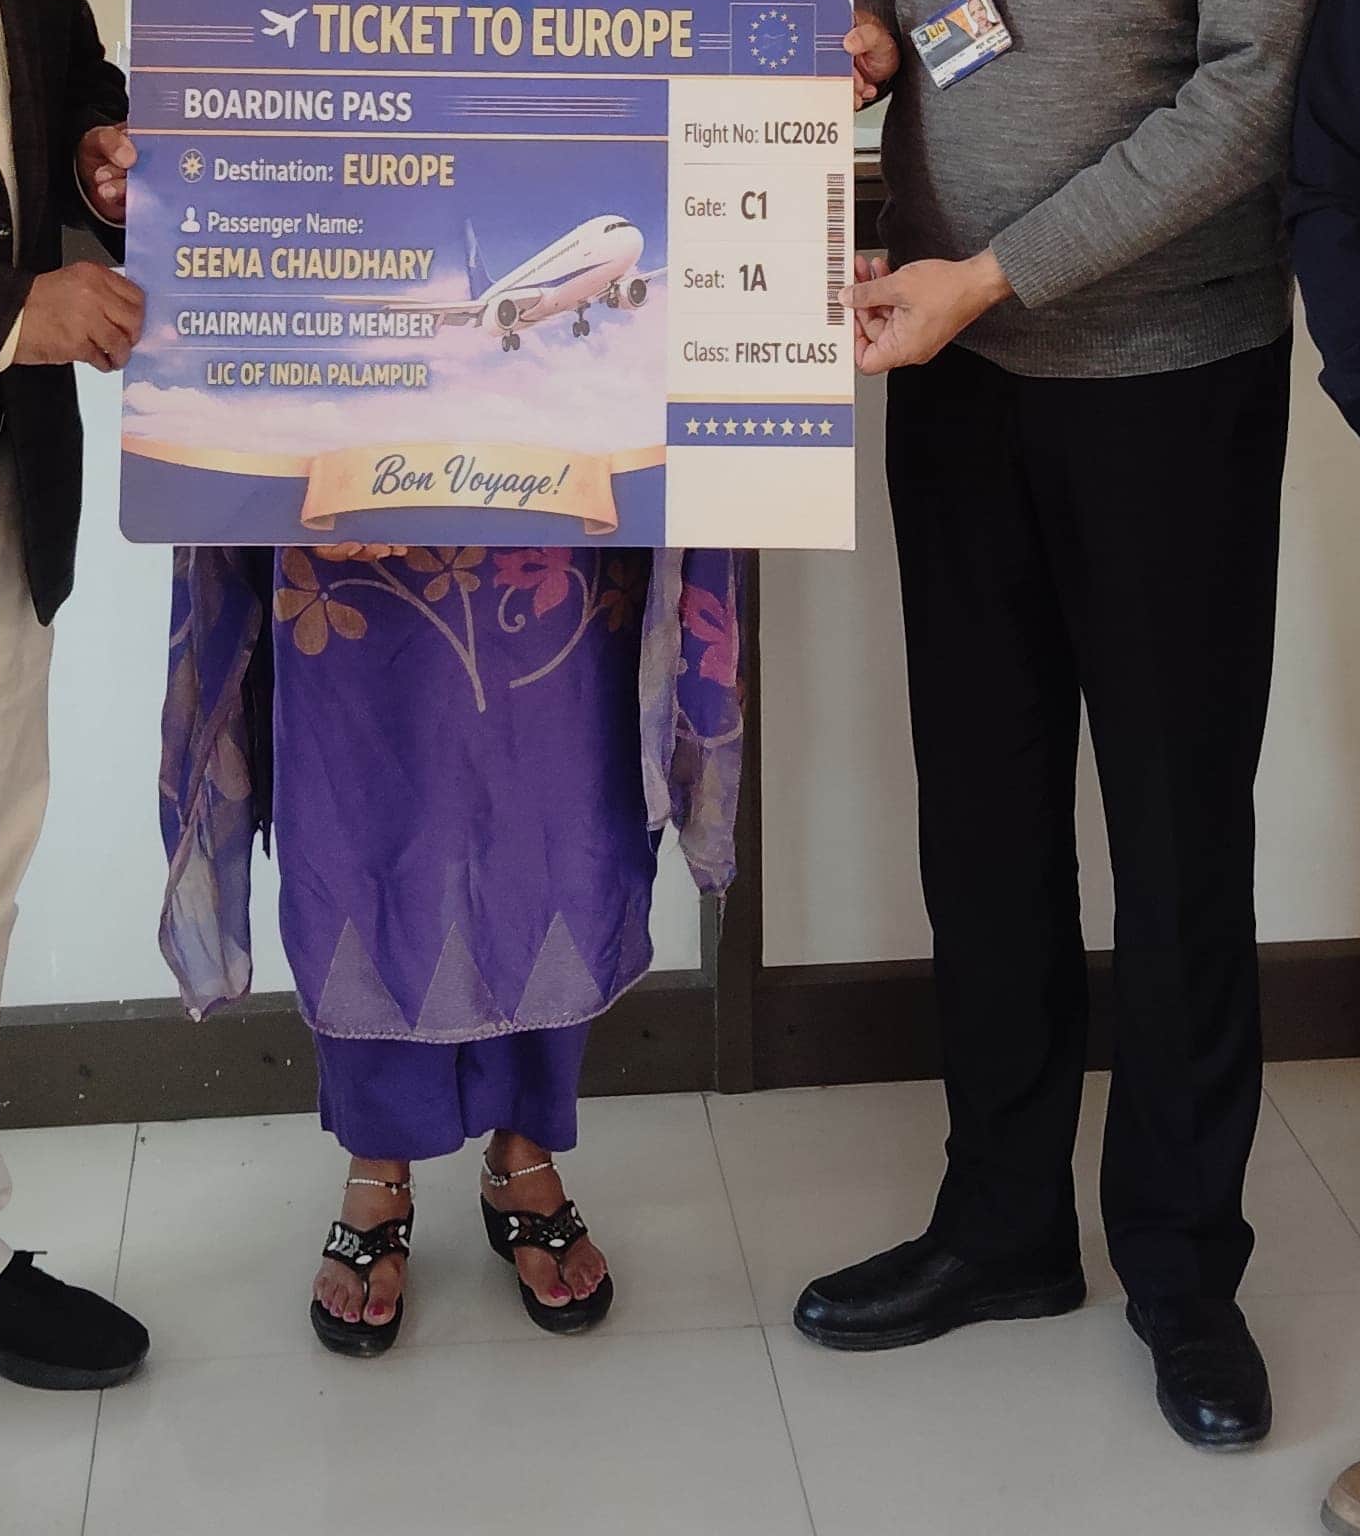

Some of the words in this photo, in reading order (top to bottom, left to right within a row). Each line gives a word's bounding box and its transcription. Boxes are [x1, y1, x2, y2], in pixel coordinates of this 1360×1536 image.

[312, 4, 458, 56] TICKET
[466, 6, 523, 56] TO
[531, 6, 694, 59] EUROPE
[183, 88, 335, 120] BOARDING
[342, 91, 412, 121] PASS
[684, 123, 728, 149] Flight
[733, 124, 759, 145] No:
[763, 121, 839, 146] LIC2026
[213, 158, 334, 184] Destination:
[343, 154, 455, 187] EUROPE
[684, 196, 727, 218] Gate:
[741, 192, 768, 220] C1
[207, 212, 302, 239] Passenger
[306, 213, 364, 234] Name:
[175, 247, 263, 279] SEEMA
[270, 249, 434, 280] CHAUDHARY
[684, 268, 725, 290] Seat:
[740, 265, 768, 292] 1A
[176, 312, 287, 337] CHAIRMAN
[292, 312, 344, 338] CLUB
[349, 313, 435, 339] MEMBER
[684, 342, 730, 364] Class:
[735, 343, 782, 365] FIRST
[786, 343, 838, 365] CLASS
[207, 363, 235, 386] LIC
[240, 363, 266, 386] OF
[270, 363, 322, 386] INDIA
[327, 364, 428, 387] PALAMPUR
[372, 455, 437, 495] Bon
[443, 455, 569, 505] Voyage!
